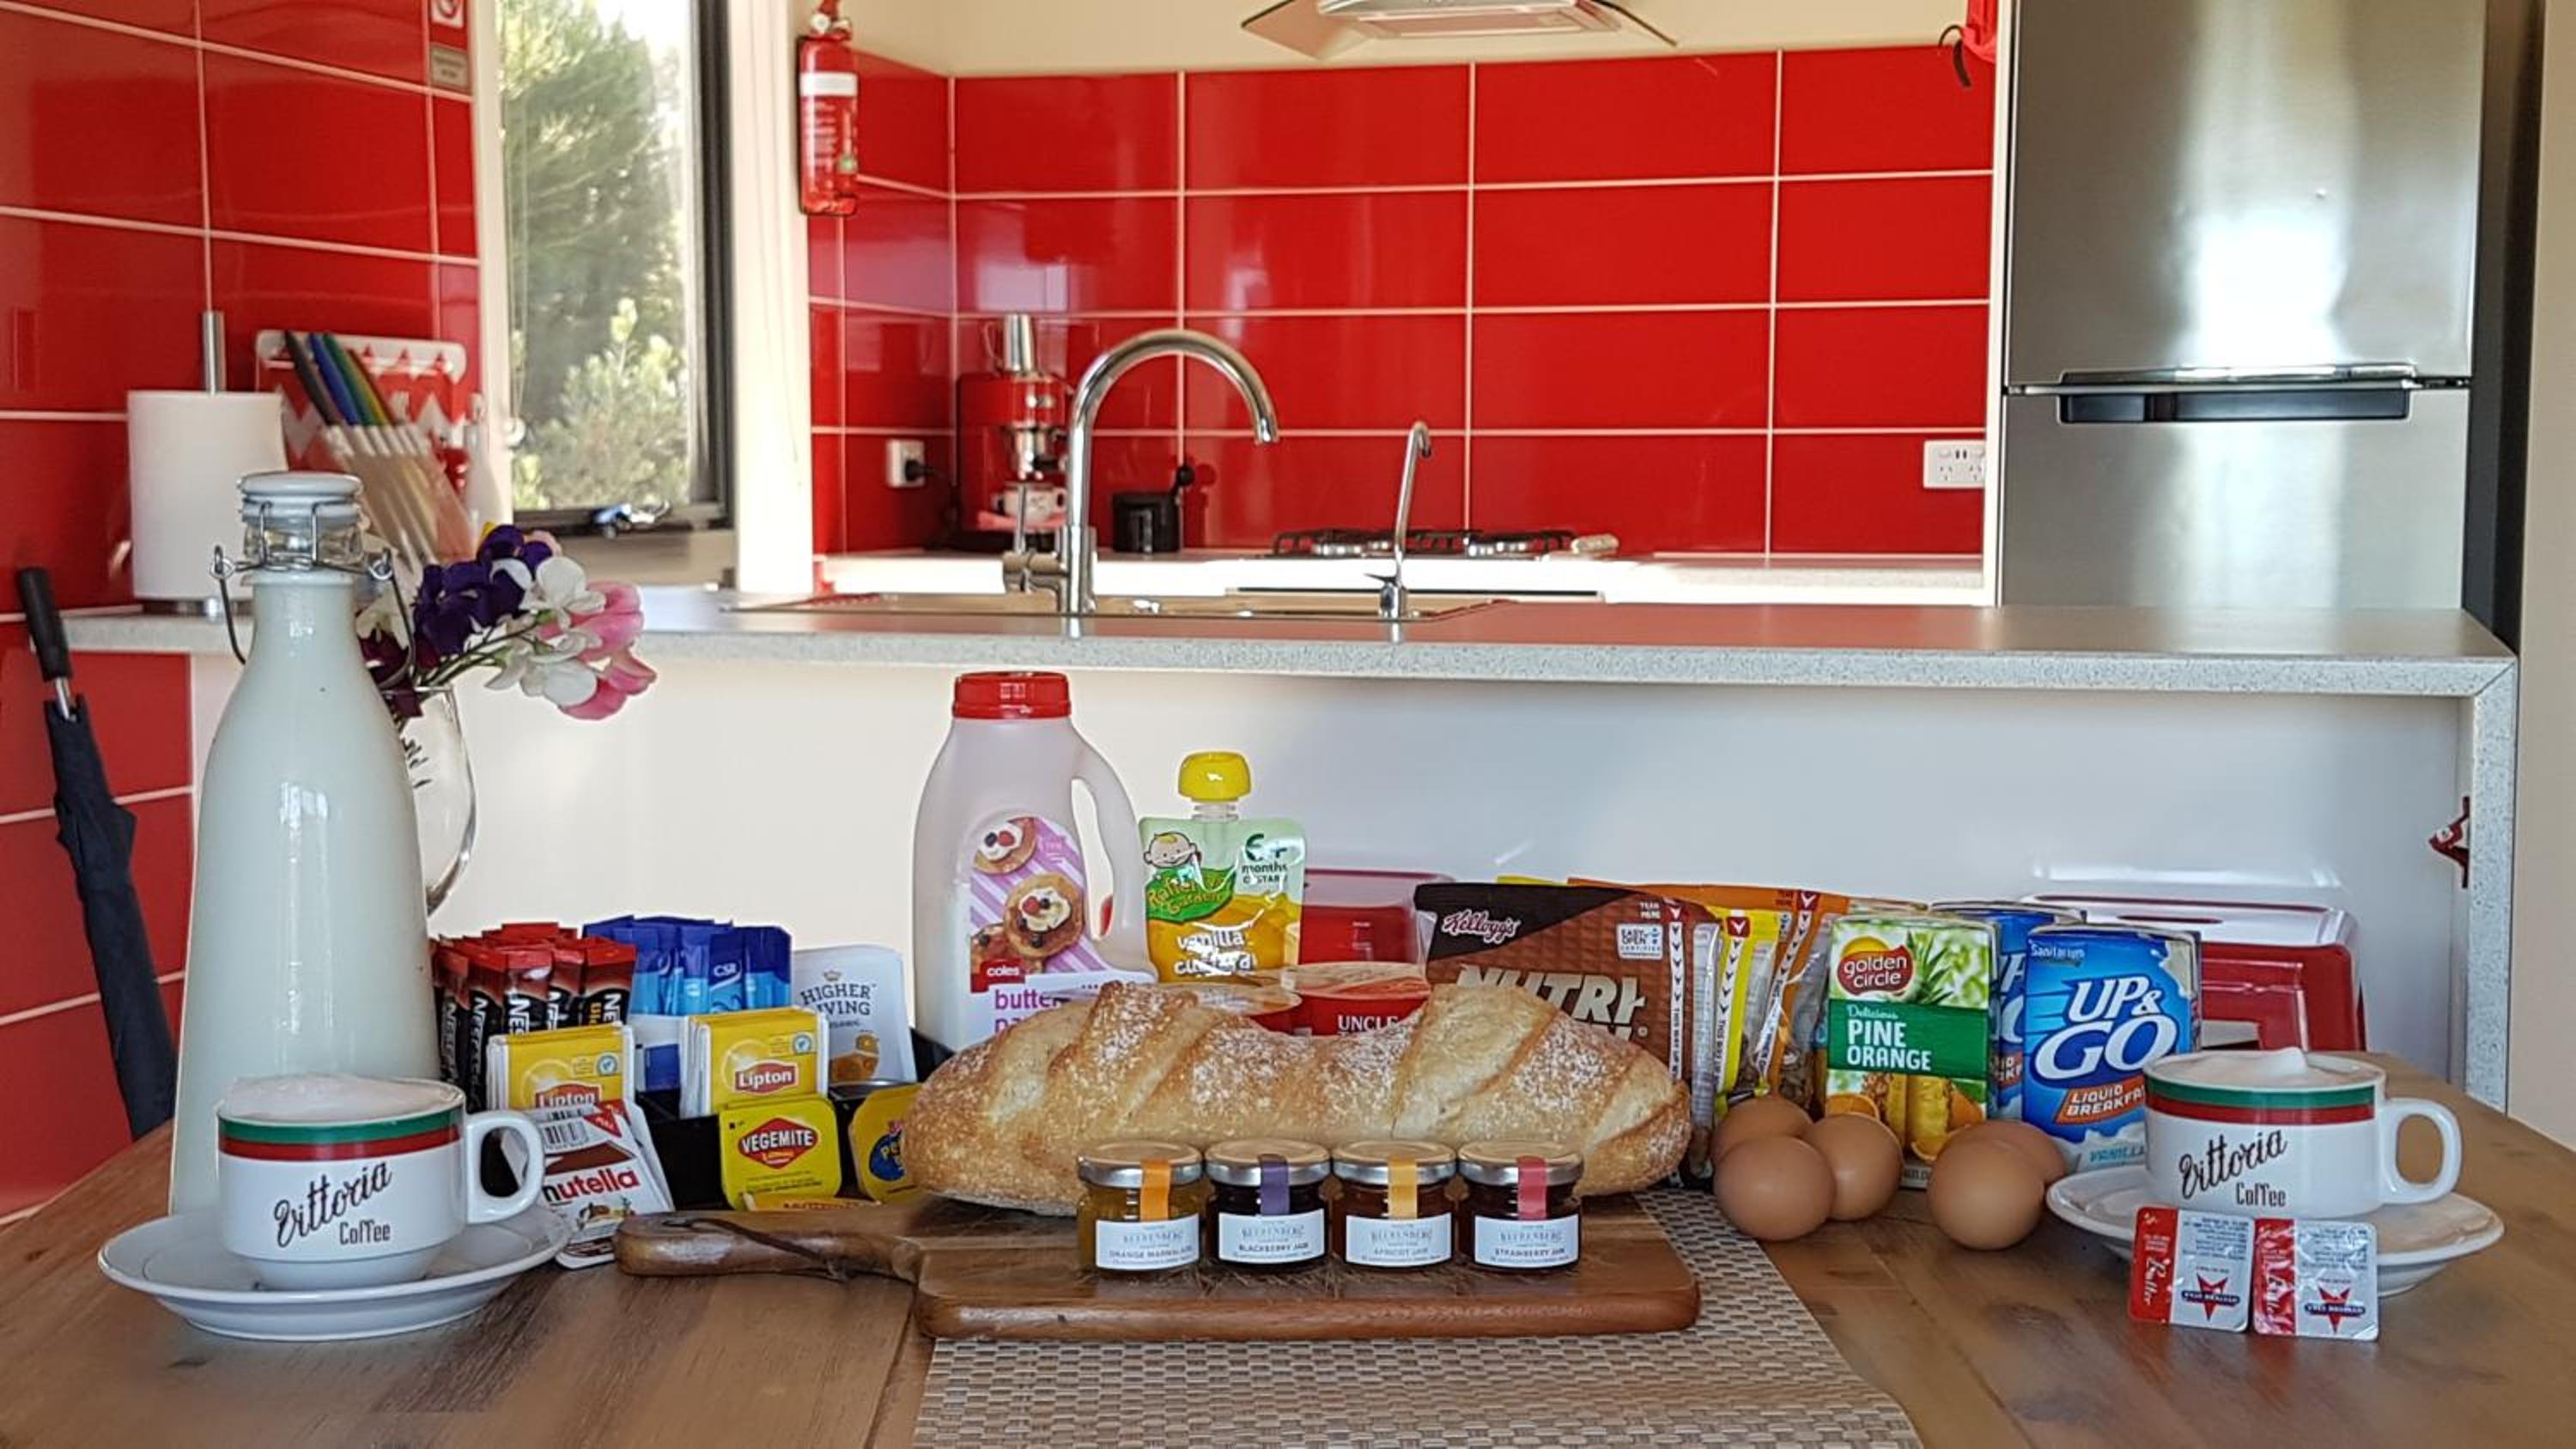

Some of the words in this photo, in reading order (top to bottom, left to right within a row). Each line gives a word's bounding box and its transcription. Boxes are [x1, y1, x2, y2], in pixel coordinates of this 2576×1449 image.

[1443, 909, 1520, 943] Kellogg's
[987, 966, 1020, 977] coles
[1844, 955, 1907, 977] golden
[1853, 973, 1901, 989] circle
[800, 983, 871, 1006] HIGHER
[817, 1000, 871, 1016] IVING
[1848, 1019, 1907, 1047] PINE
[1847, 1045, 1931, 1071] ORANGE
[2034, 1014, 2178, 1080] GO
[737, 1069, 793, 1089] Lipton
[2066, 1085, 2145, 1116] BREAKFA
[2071, 1084, 2123, 1104] LIQUID
[741, 1129, 815, 1154] VEGEMITE
[2178, 1129, 2288, 1200] Vittoria
[543, 1167, 641, 1203] nutella
[2235, 1181, 2287, 1207] Coffee
[274, 1161, 392, 1248] Vittoria
[339, 1220, 392, 1246] Coffee
